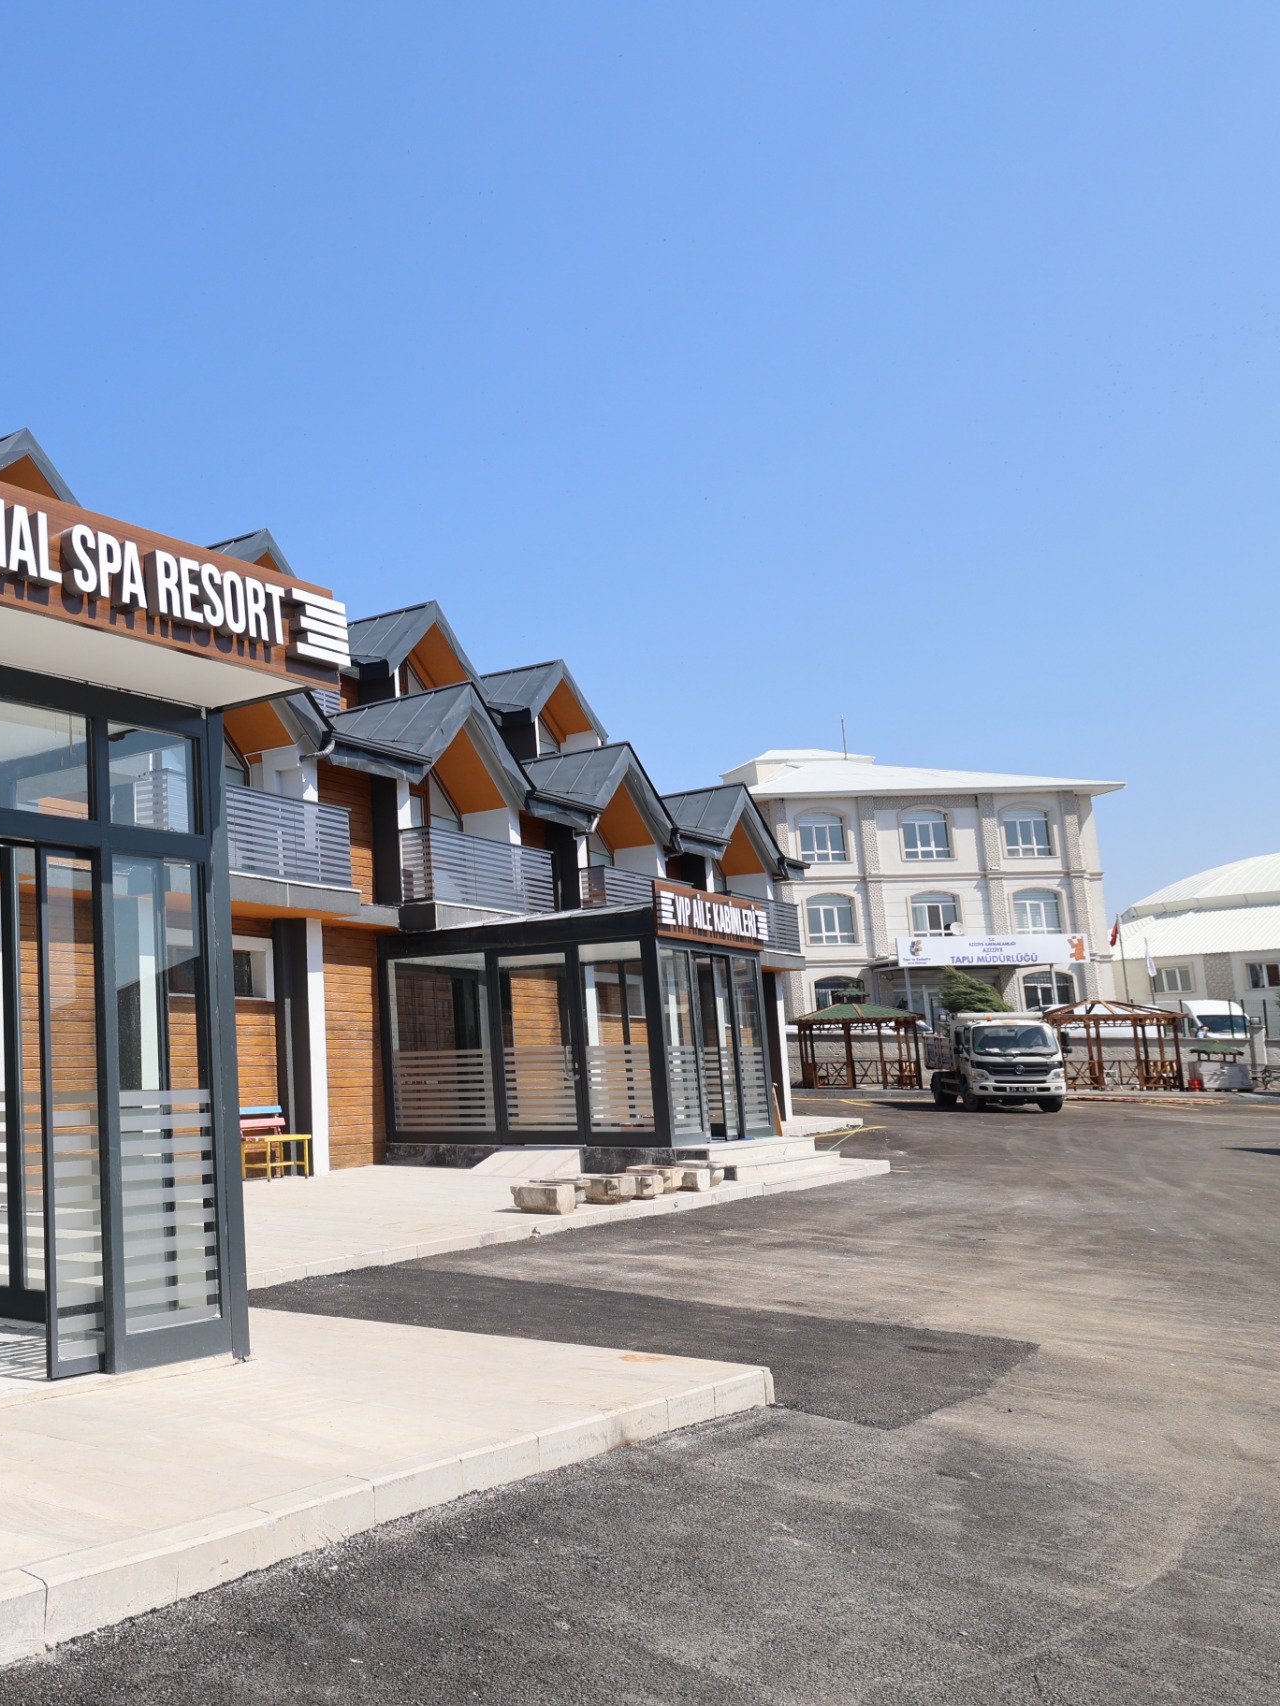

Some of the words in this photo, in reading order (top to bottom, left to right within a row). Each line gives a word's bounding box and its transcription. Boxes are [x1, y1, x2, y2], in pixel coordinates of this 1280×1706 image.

[70, 524, 147, 609] SPA
[157, 550, 287, 645] RESORT
[675, 895, 691, 926] VIP
[694, 893, 713, 931] AİLE
[713, 900, 757, 938] KABİNLERİ
[950, 956, 974, 964] TAPU
[976, 953, 1038, 963] MÜDÜRLÜĞÜ
